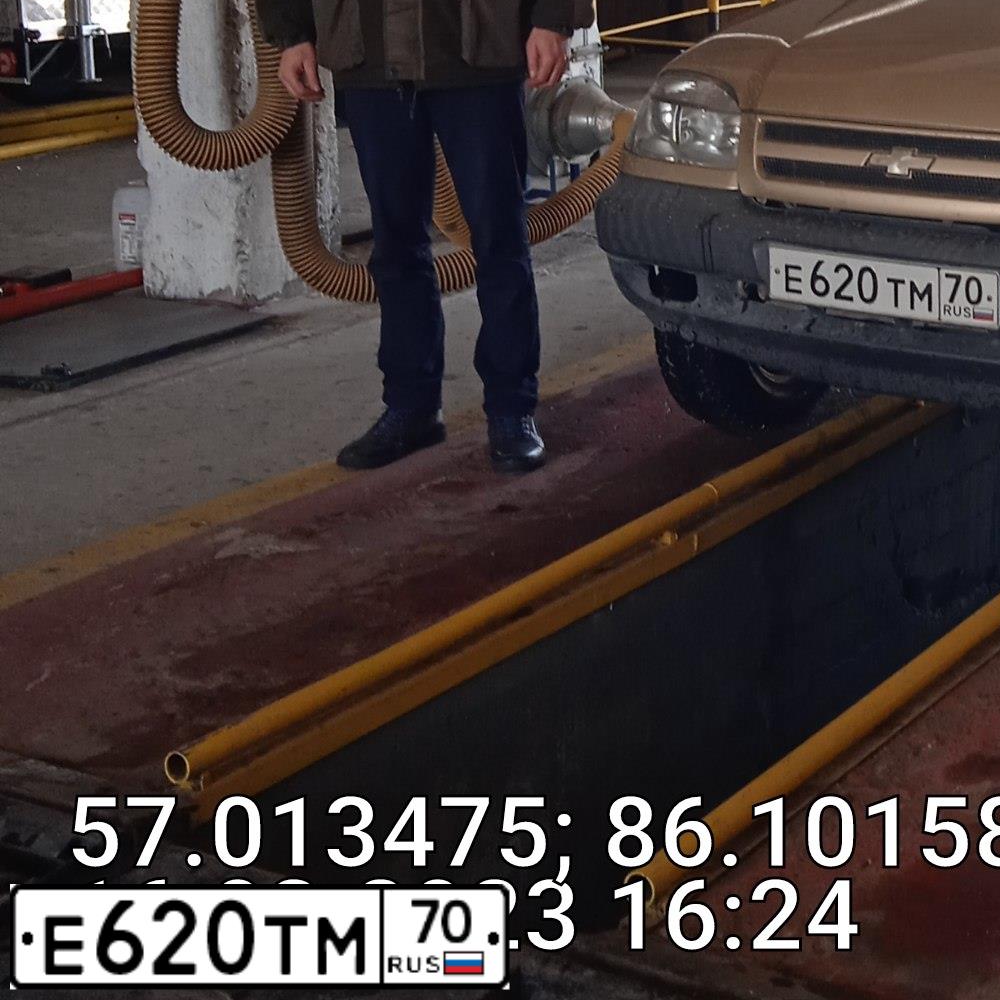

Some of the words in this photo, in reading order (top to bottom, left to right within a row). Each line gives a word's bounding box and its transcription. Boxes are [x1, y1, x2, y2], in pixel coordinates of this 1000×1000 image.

[784, 260, 933, 312] Е620ТМ
[944, 273, 983, 305] 70
[943, 305, 971, 318] RUS
